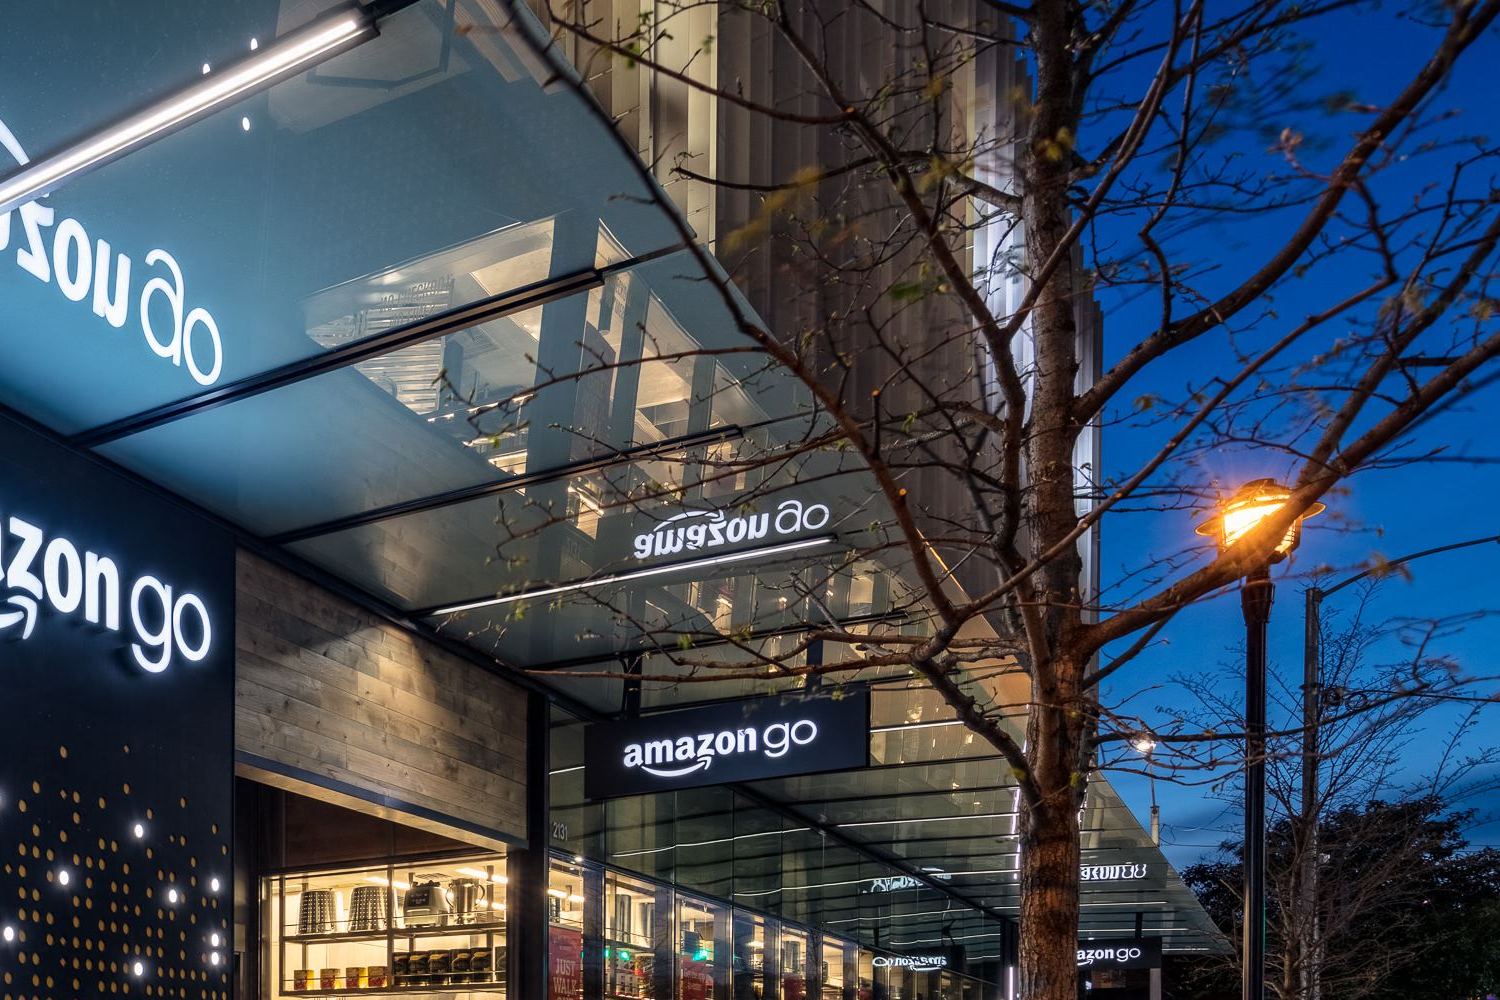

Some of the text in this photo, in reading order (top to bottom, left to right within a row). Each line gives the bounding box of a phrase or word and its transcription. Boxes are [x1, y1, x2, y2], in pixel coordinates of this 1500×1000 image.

[130, 575, 211, 674] go
[623, 719, 818, 778] amazon go
[553, 822, 568, 841] 2131
[1077, 947, 1141, 966] azon go
[555, 958, 576, 977] JUST
[553, 976, 577, 996] WALK
